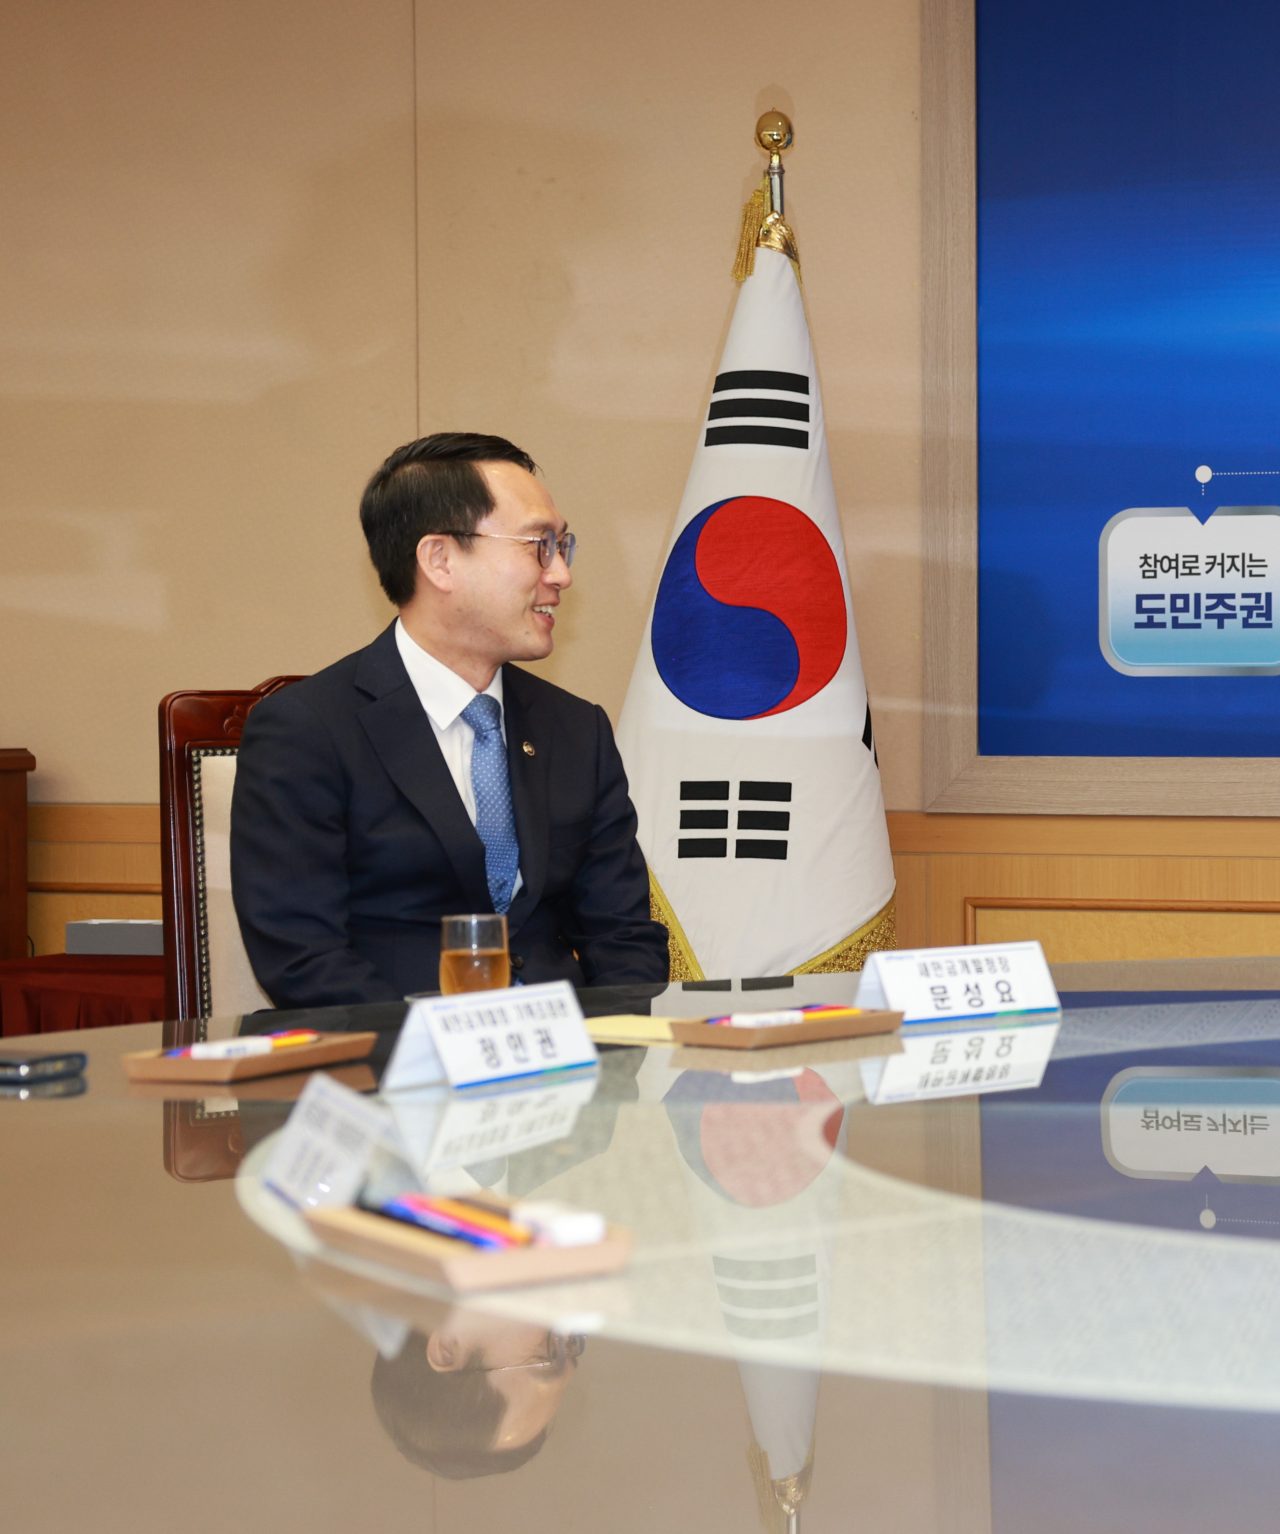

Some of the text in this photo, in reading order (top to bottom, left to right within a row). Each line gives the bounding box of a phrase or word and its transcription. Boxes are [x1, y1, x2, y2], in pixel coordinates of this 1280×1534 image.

[1138, 552, 1268, 579] 참여로 커지는
[1133, 591, 1273, 630] 도민주권
